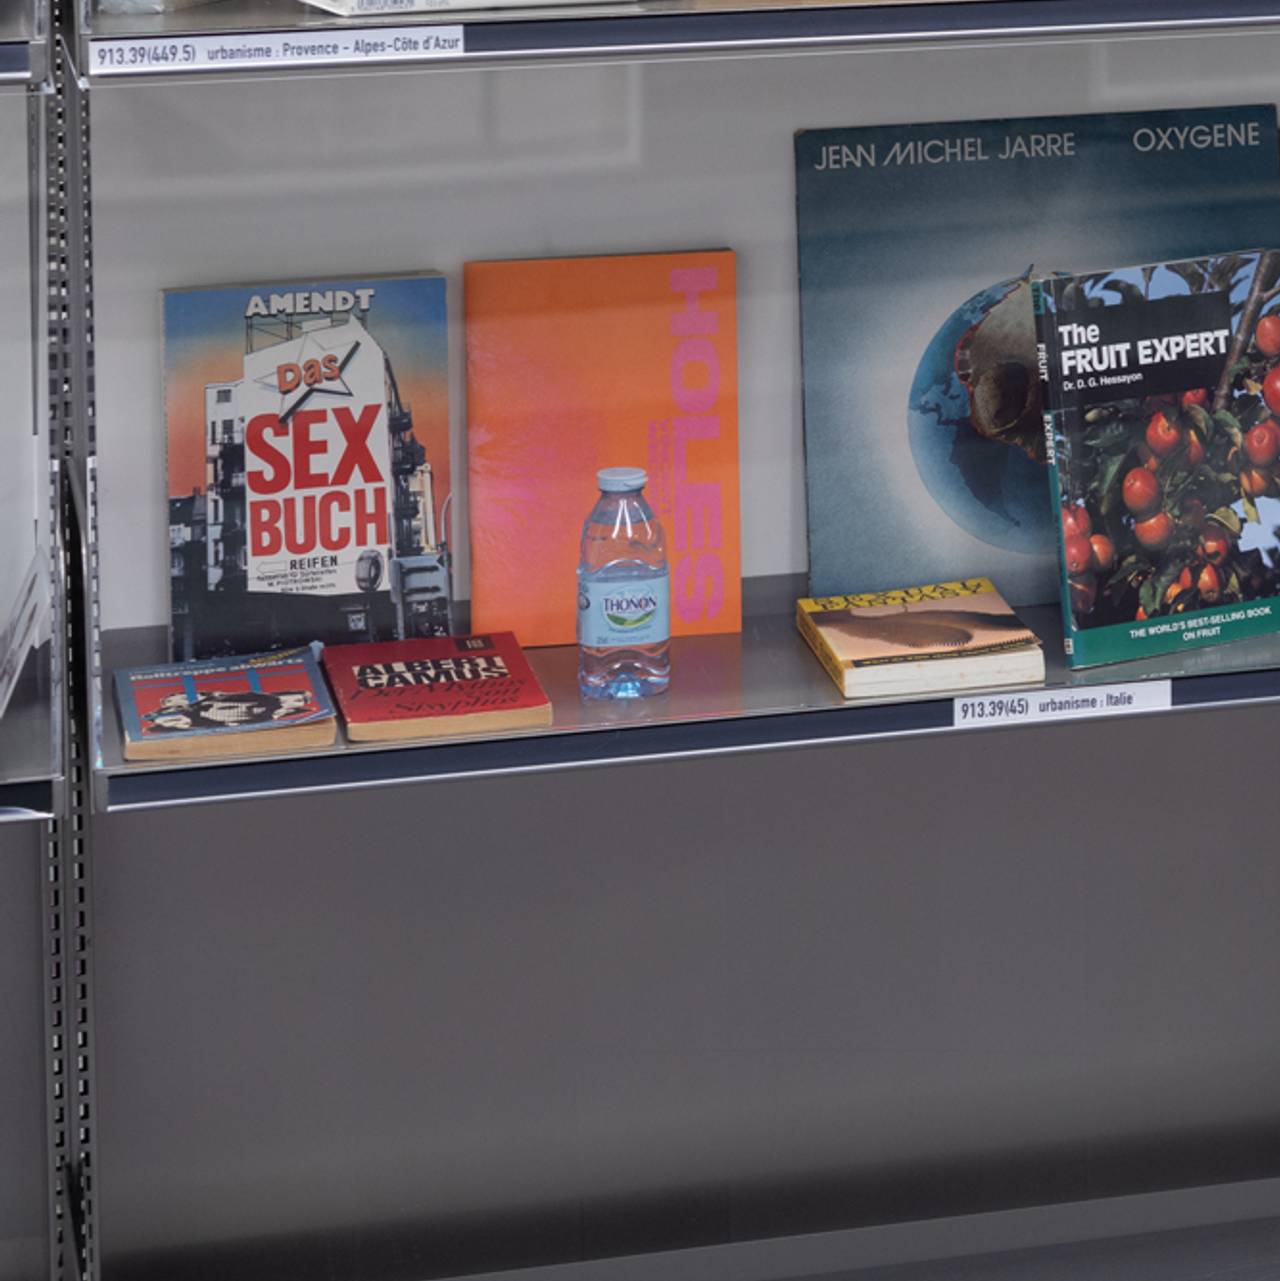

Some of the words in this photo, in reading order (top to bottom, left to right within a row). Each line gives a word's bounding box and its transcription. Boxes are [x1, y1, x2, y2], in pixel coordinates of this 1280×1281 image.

[98, 47, 196, 65] 913.39(449.5)
[208, 45, 271, 60] urbanisme
[282, 40, 338, 57] Provence
[354, 38, 420, 55] Alpes-Côte
[422, 36, 460, 52] d'Azur
[814, 144, 876, 171] JEAN
[882, 138, 990, 166] MICHEL
[997, 132, 1076, 162] JARRE
[1133, 124, 1260, 153] OXYGENE
[244, 289, 375, 317] AMENDT
[1059, 323, 1100, 347] The
[1062, 343, 1130, 376] FRUIT
[1138, 328, 1230, 365] EXPERT
[277, 352, 340, 394] Das
[1064, 380, 1076, 392] Dr.
[1078, 378, 1087, 390] D.
[1088, 376, 1098, 388] G.
[1100, 371, 1143, 389] Hessayon
[1036, 342, 1048, 382] FRUIT
[1044, 413, 1056, 466] EXPERT
[246, 404, 384, 494] SEX
[668, 267, 725, 622] HOLES
[249, 486, 390, 557] BUCH
[290, 556, 338, 570] REIFEN
[604, 596, 656, 612] THONON
[1130, 627, 1146, 640] THE
[1148, 621, 1186, 638] WORLD'S
[1186, 612, 1246, 631] BEST-SELLING
[1248, 606, 1272, 620] BOOK
[1182, 631, 1195, 642] ON
[1197, 626, 1221, 640] FRUIT
[356, 656, 503, 678] ALBERT
[358, 666, 511, 690] CAMUS
[961, 698, 1028, 719] 913.39(45)
[1038, 696, 1098, 712] urbanisme
[1106, 692, 1134, 706] Italie
